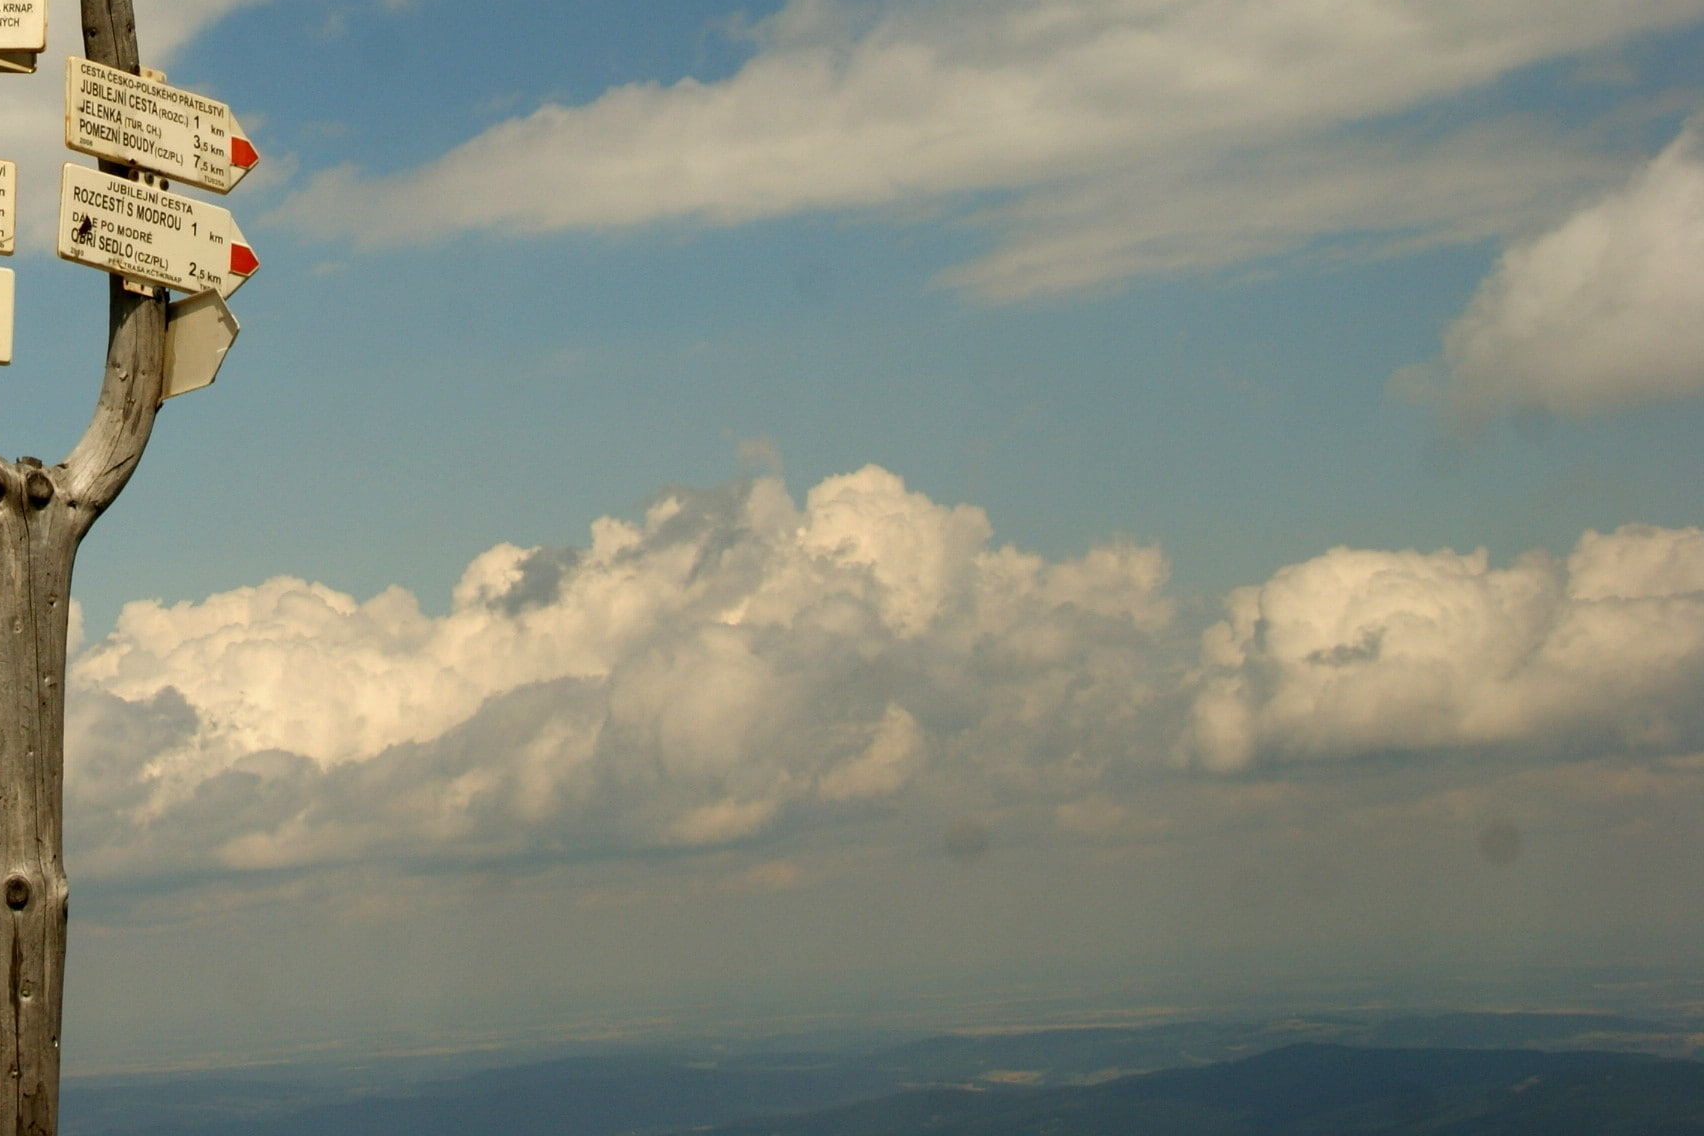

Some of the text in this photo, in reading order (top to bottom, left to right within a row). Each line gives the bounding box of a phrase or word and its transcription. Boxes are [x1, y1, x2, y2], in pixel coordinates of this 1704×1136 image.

[3, 3, 33, 13] KRNAP.
[80, 79, 224, 137] JUBILEJNÍ CESTA (ROZC.) 1 km
[81, 63, 224, 119] CESTA ČESKO-POLSKÉHO PŘÁTELSTVÍ
[79, 118, 224, 177] POMEZNÍ BOUDY (CZ/PL) 7,5 km
[80, 99, 123, 125] JELENKA
[193, 134, 208, 152] 3,5
[210, 144, 224, 157] km
[73, 185, 224, 244] ROZCESTÍ S MODROU 1 km
[107, 181, 193, 215] JUBILEJNÍ CESTA
[99, 235, 133, 258] SEDLO
[134, 250, 169, 271] (CZ/PL)
[188, 261, 205, 280] 2,5
[207, 271, 222, 285] km
[101, 220, 114, 232] PO
[117, 224, 153, 244] MODRÉ
